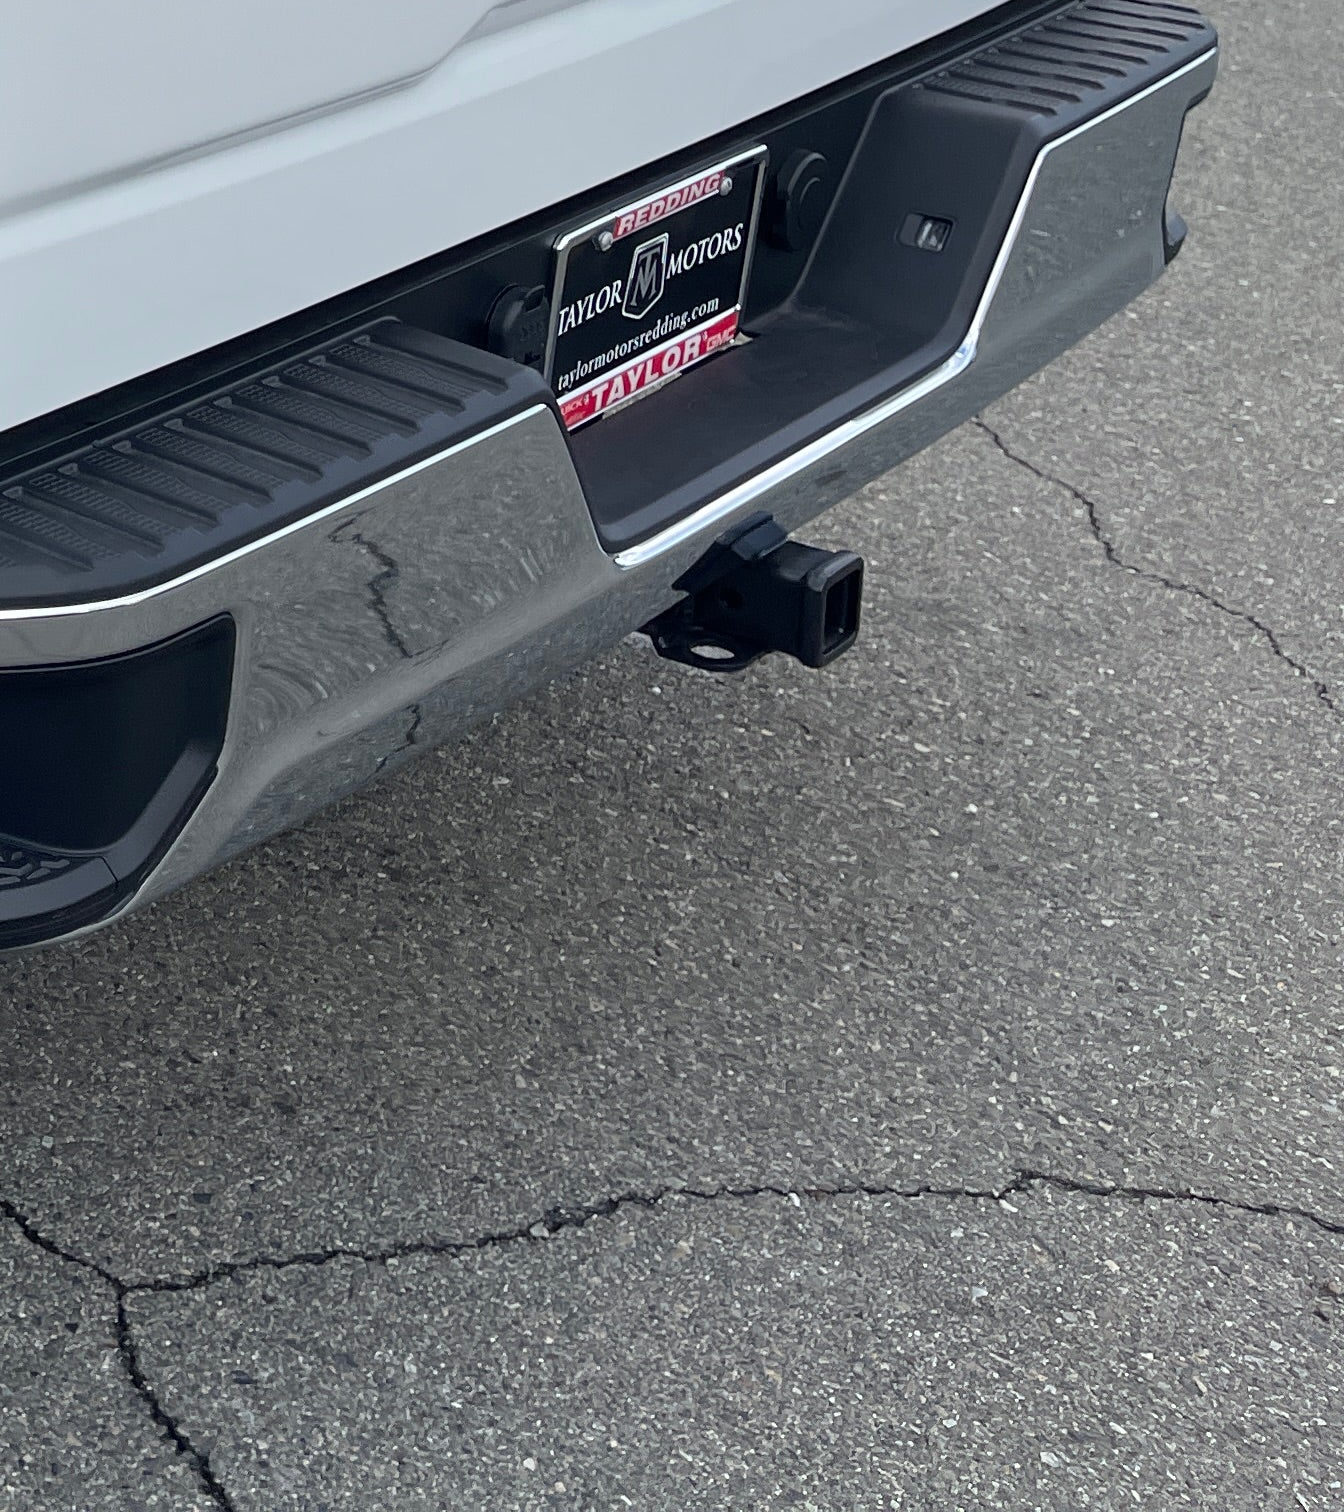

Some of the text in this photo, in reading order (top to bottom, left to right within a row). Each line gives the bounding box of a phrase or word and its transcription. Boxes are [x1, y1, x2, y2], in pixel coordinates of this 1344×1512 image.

[617, 173, 721, 236] REDDING
[558, 279, 623, 336] TAYLOR
[666, 223, 744, 279] MOTORS
[558, 297, 720, 391] taylormotorsredding.com
[592, 334, 701, 412] TAYLOR
